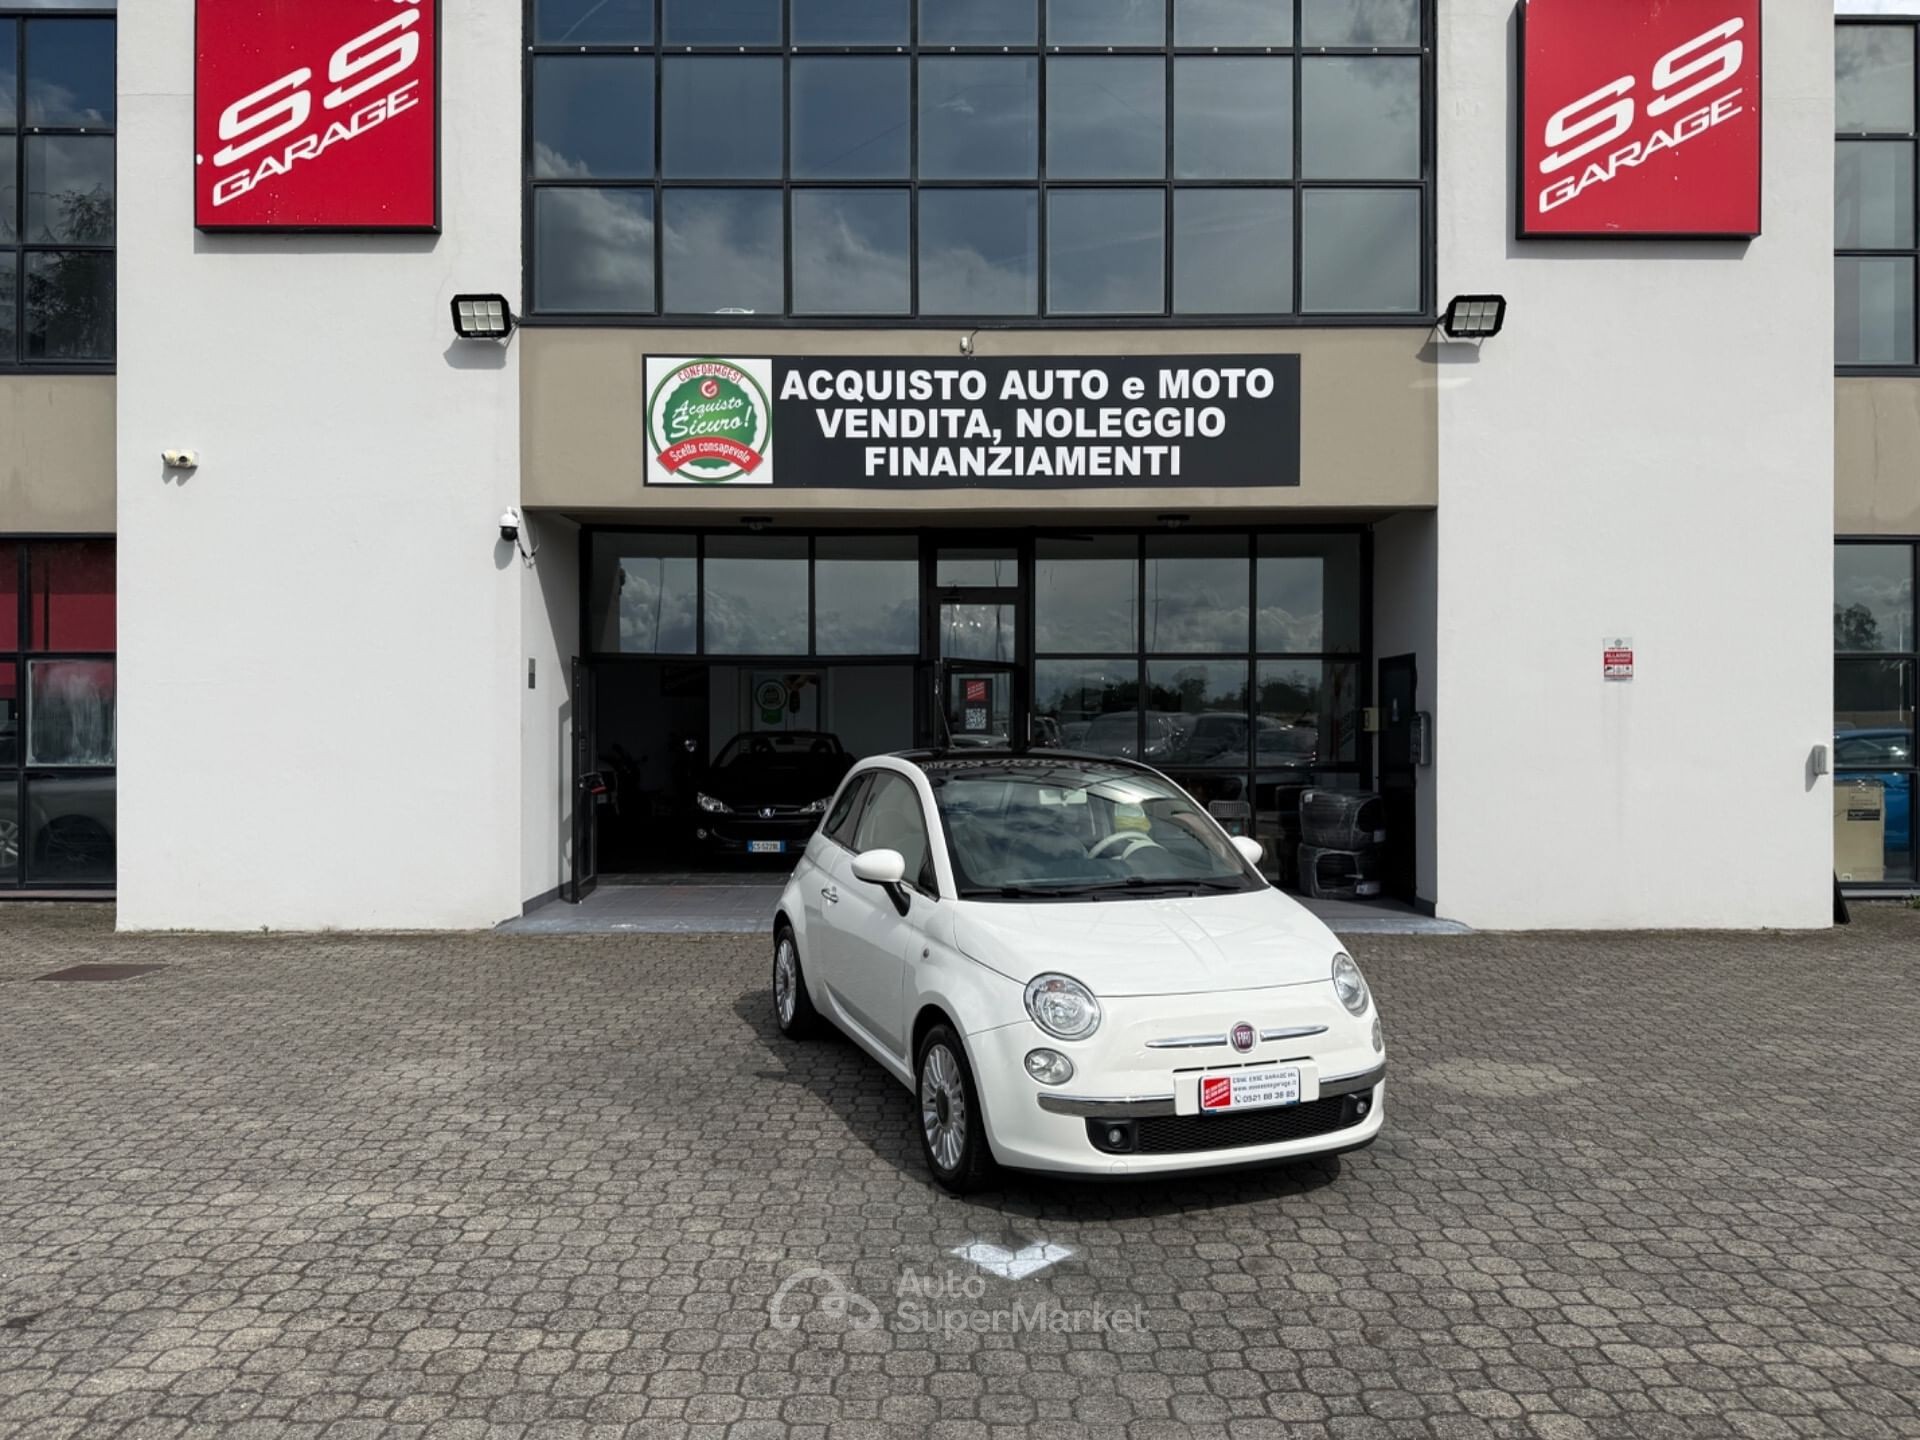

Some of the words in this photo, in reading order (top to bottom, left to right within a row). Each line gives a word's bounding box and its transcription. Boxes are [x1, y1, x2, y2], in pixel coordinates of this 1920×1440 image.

[213, 79, 419, 207] GARAGE
[1539, 87, 1743, 214] GARAGE
[678, 363, 744, 384] CONFORMGEST
[780, 369, 987, 403] ACQUISTO
[1000, 369, 1109, 400] AUTO
[1122, 376, 1145, 400] e
[1158, 368, 1274, 399] MOTO
[670, 405, 752, 438] Sicuro!
[672, 397, 744, 419] Acquisto
[816, 408, 1002, 445] VENDITA,
[1016, 407, 1226, 438] NOLEGGIO
[669, 442, 697, 462] Scelta
[698, 442, 751, 463] consapevole
[865, 446, 1181, 477] FINANZIAMENTI
